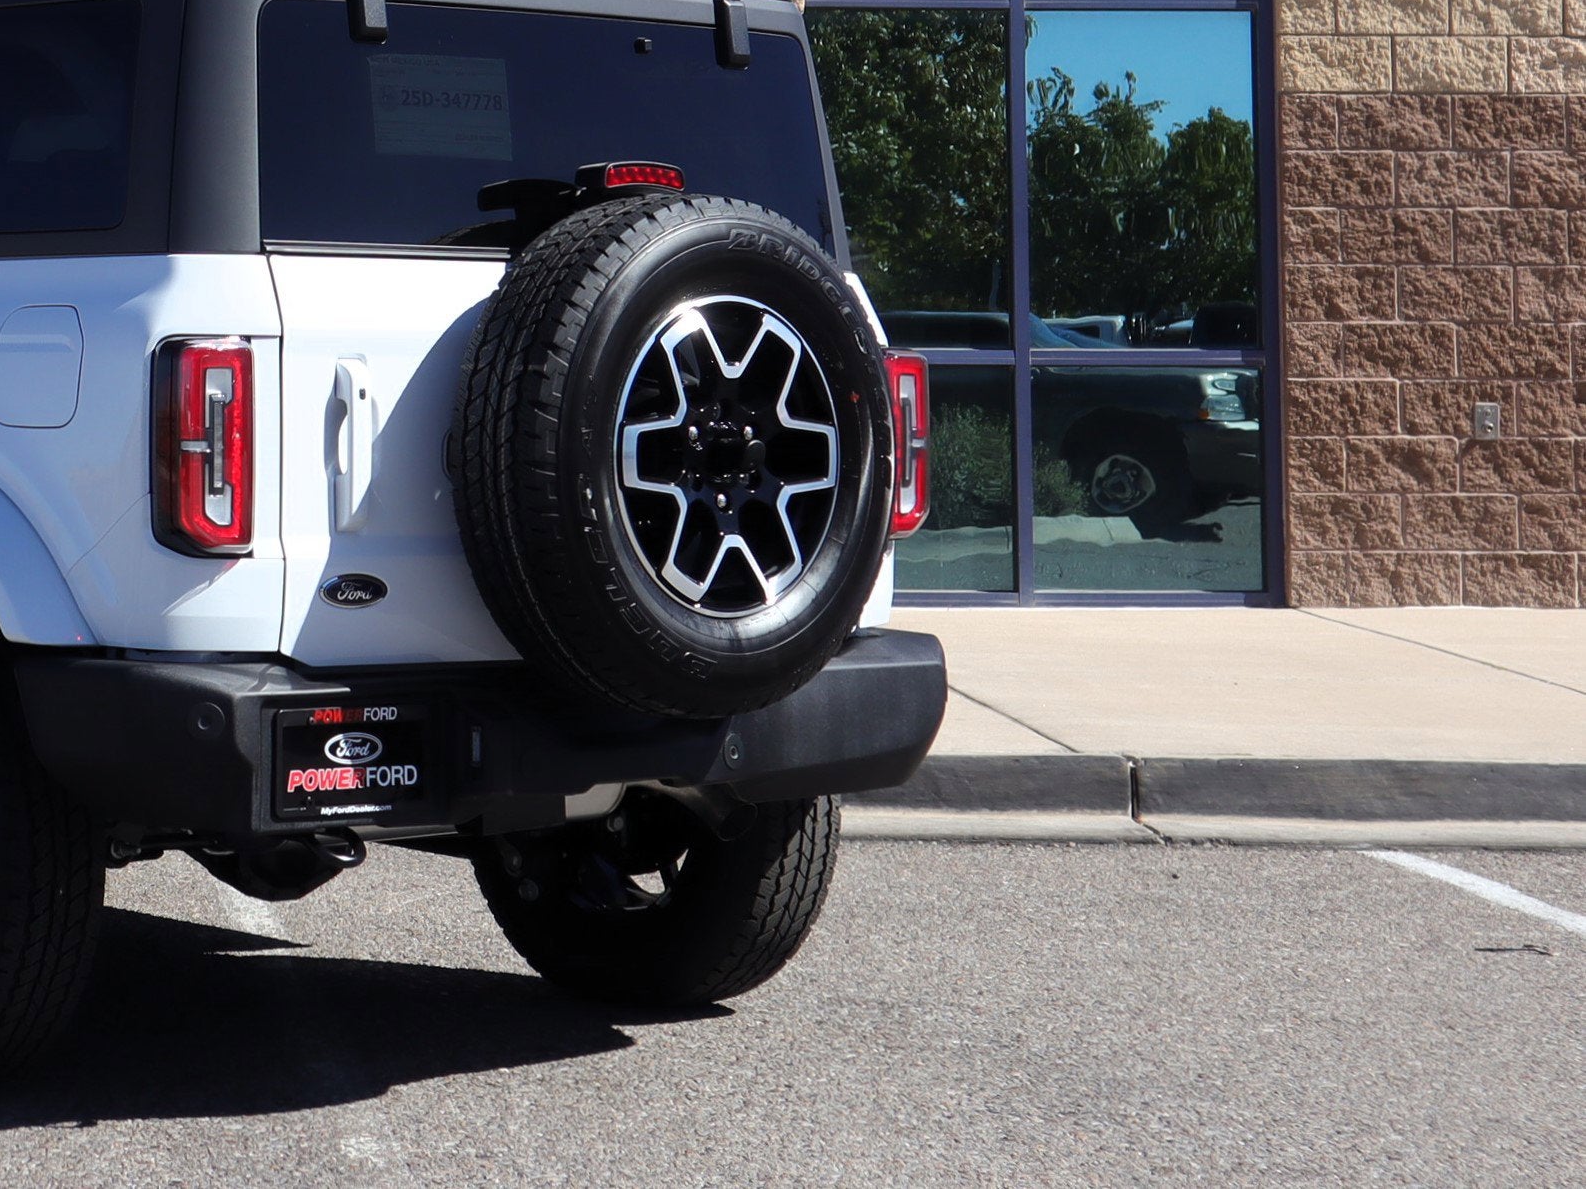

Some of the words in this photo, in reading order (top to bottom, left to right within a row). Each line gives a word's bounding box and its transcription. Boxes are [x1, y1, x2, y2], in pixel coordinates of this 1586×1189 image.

[401, 89, 503, 111] 25D-347778
[337, 581, 374, 601] Ford
[333, 738, 370, 758] Ford
